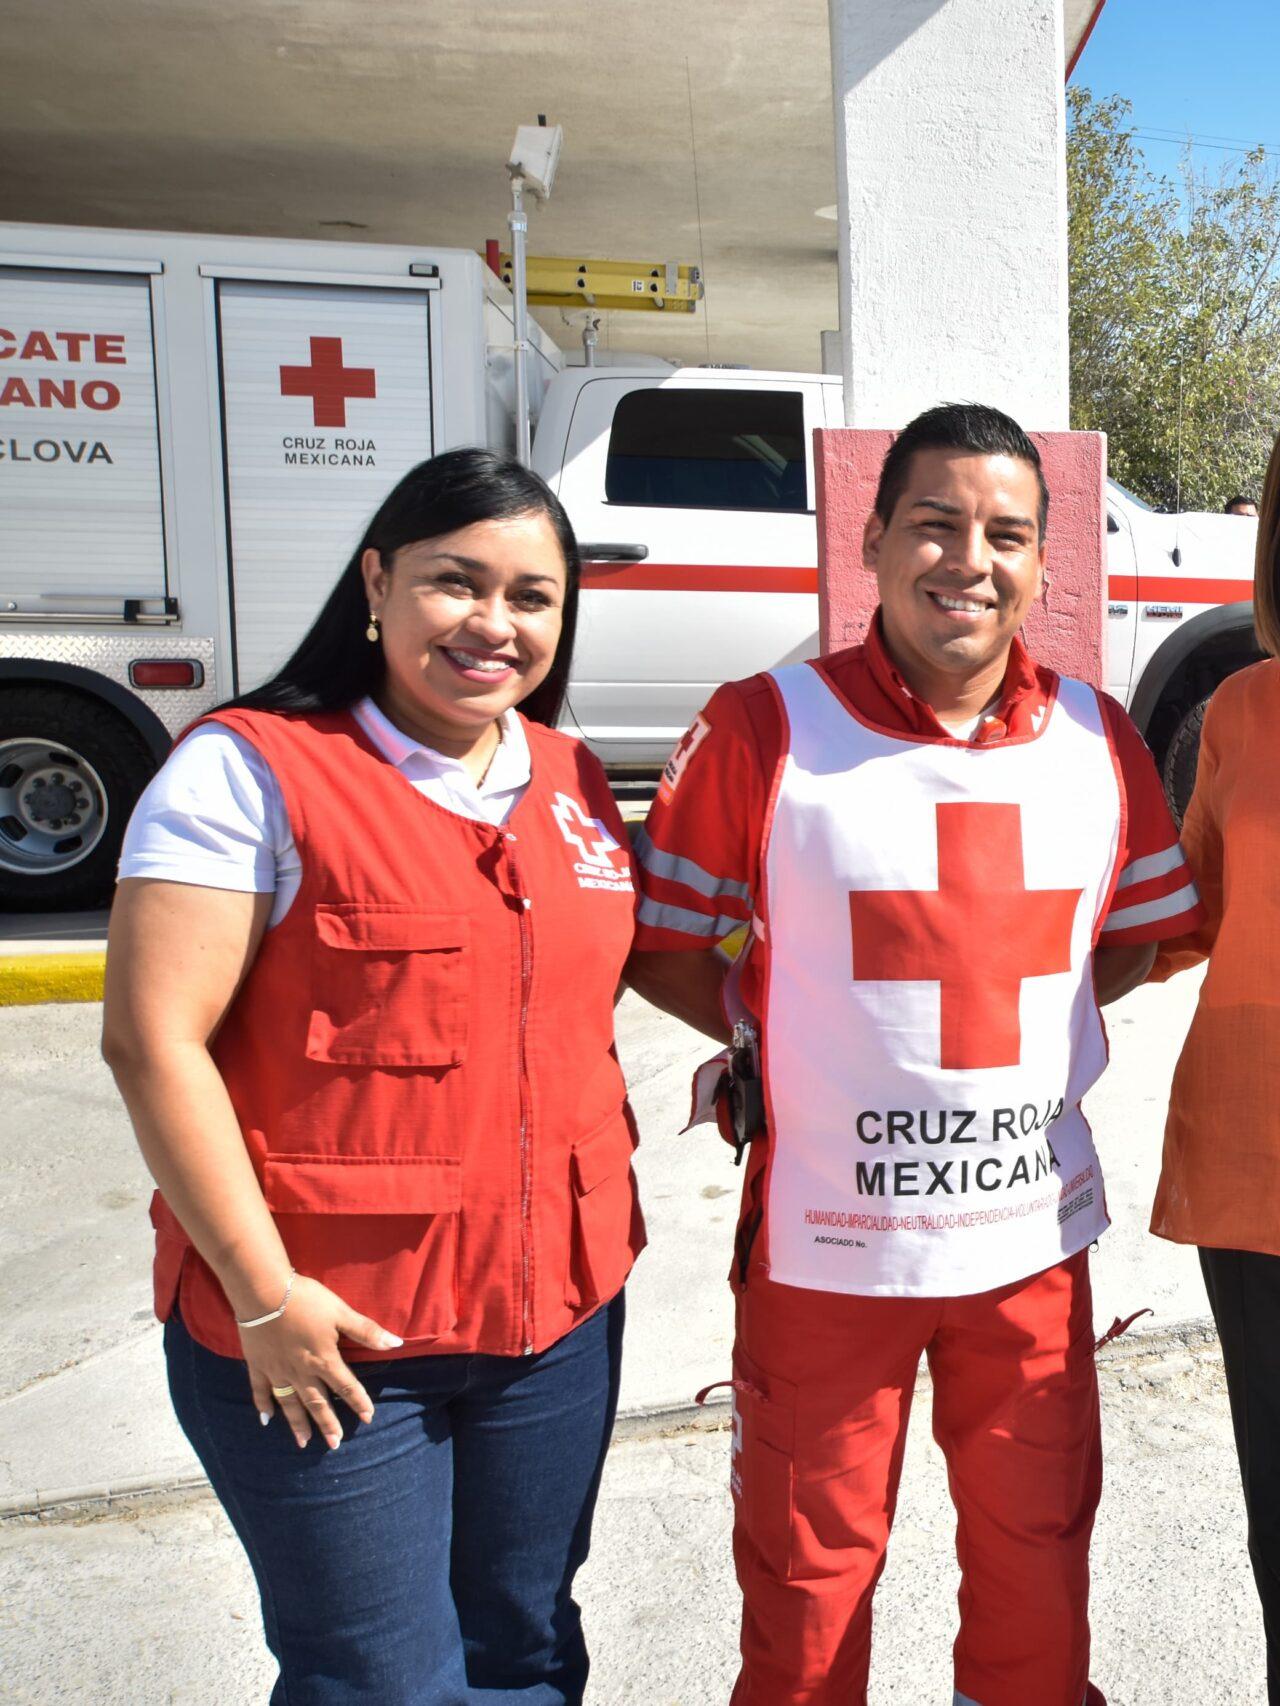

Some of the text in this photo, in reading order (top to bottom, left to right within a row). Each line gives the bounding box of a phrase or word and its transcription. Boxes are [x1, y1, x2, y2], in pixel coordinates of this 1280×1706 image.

[0, 377, 121, 411] ANO
[0, 438, 114, 464] LOVA
[282, 436, 376, 451] CRUZ ROJA
[284, 452, 376, 467] MEXICANA
[856, 1097, 1064, 1145] CRUZ ROJA
[855, 1138, 1061, 1197] MEXICANA
[814, 1235, 867, 1248] ASOCIADO No.
